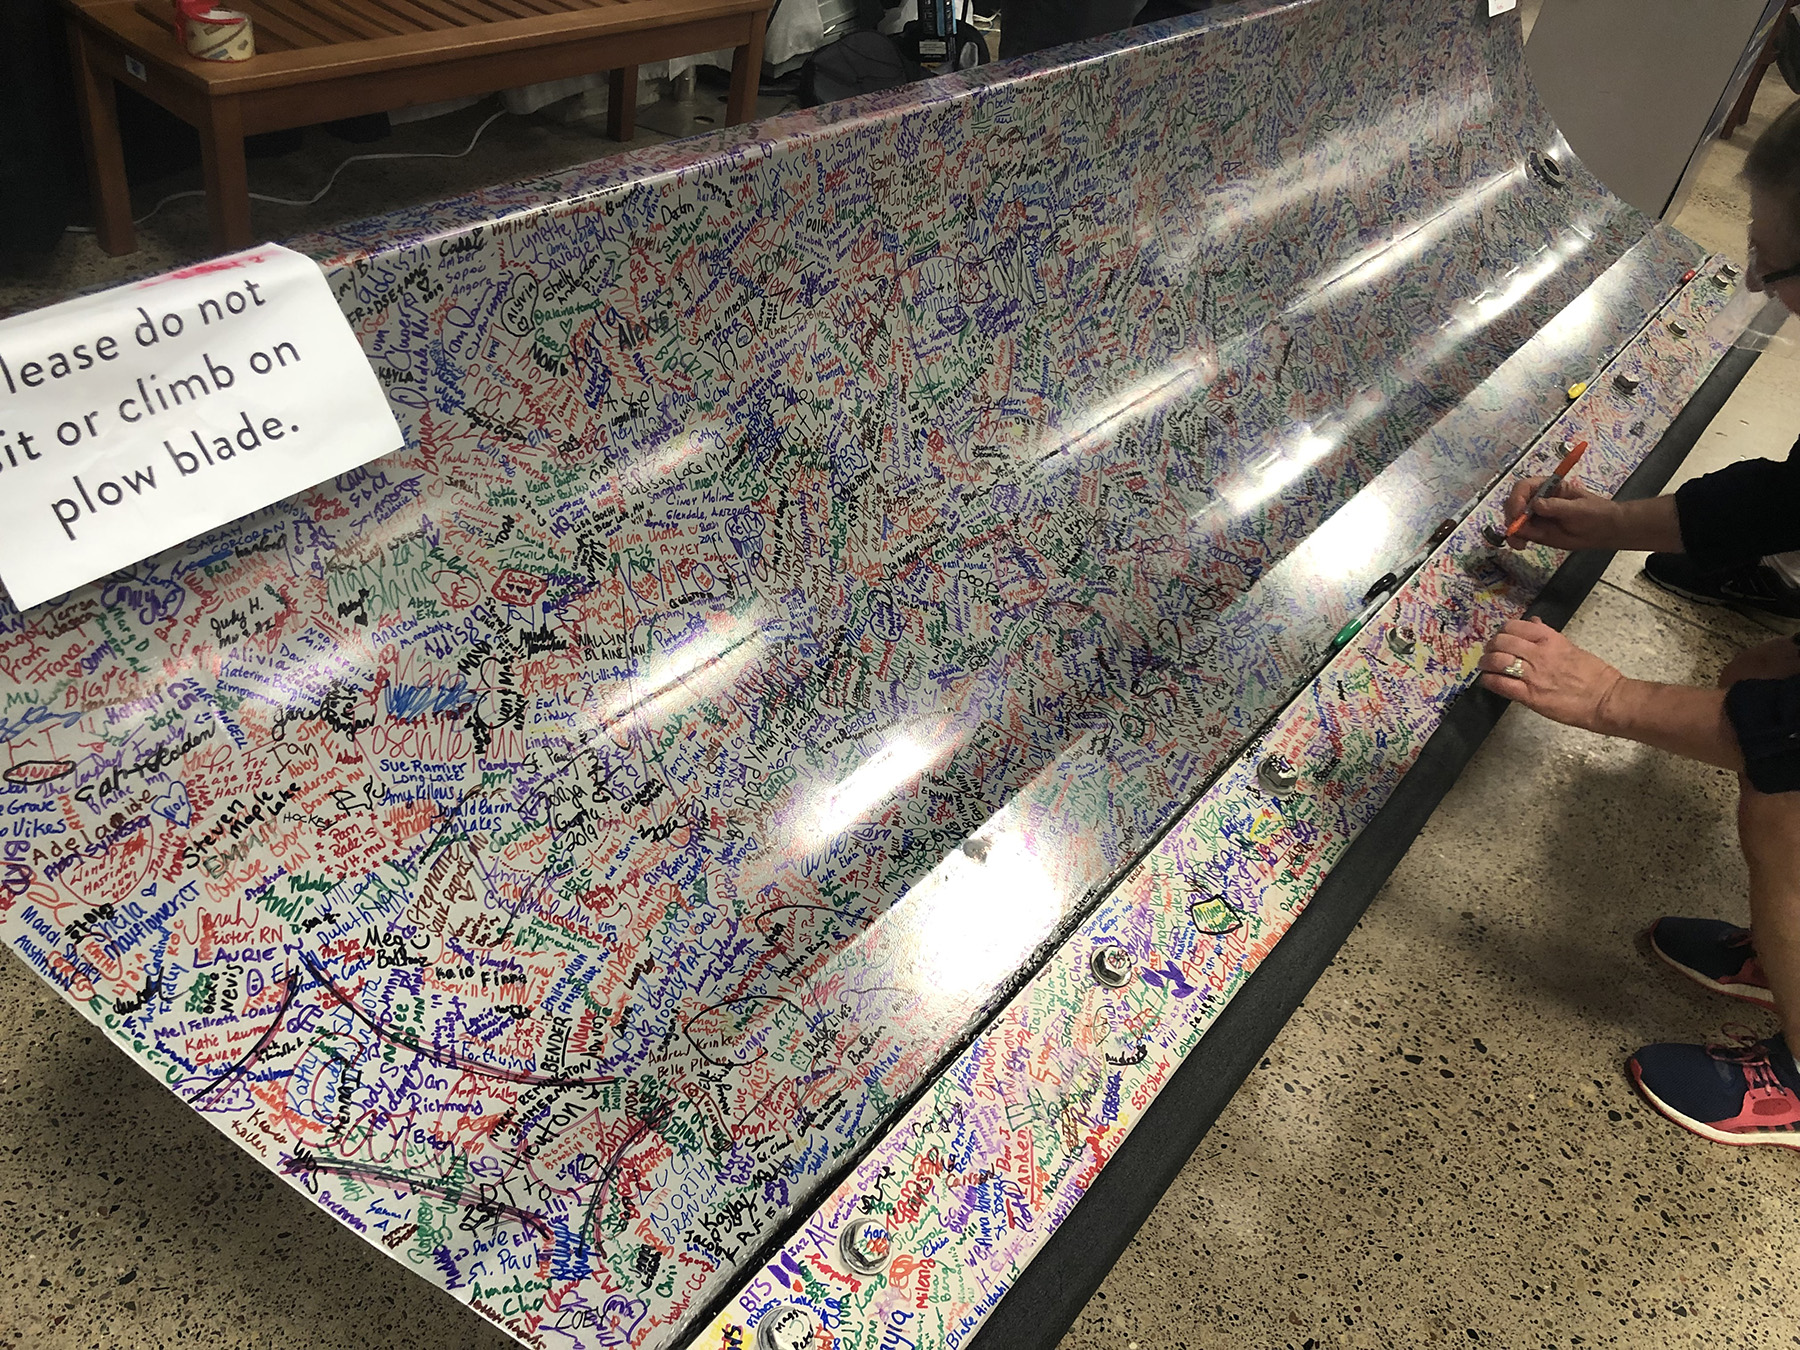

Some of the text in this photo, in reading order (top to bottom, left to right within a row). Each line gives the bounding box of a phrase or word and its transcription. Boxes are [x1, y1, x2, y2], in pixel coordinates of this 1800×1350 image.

[0, 279, 268, 395] lease do not
[0, 340, 302, 472] it or climb on
[50, 411, 300, 541] plow blade.
[407, 597, 437, 610] Abby
[210, 609, 247, 637] Judy
[371, 615, 418, 649] Andrew
[228, 645, 291, 671] Alivia
[296, 719, 329, 742] Jim
[288, 757, 319, 779] Abby
[379, 759, 410, 773] Sue
[392, 773, 426, 790] Long
[14, 818, 67, 839] Vikes
[182, 799, 245, 870] Steven
[20, 905, 60, 948] Maddi
[259, 925, 283, 943] RN
[364, 925, 407, 950] Meg
[192, 946, 278, 969] LAURIE
[648, 1045, 691, 1067] Andrew
[472, 1230, 510, 1257] Dave
[738, 1276, 772, 1314] BTS
